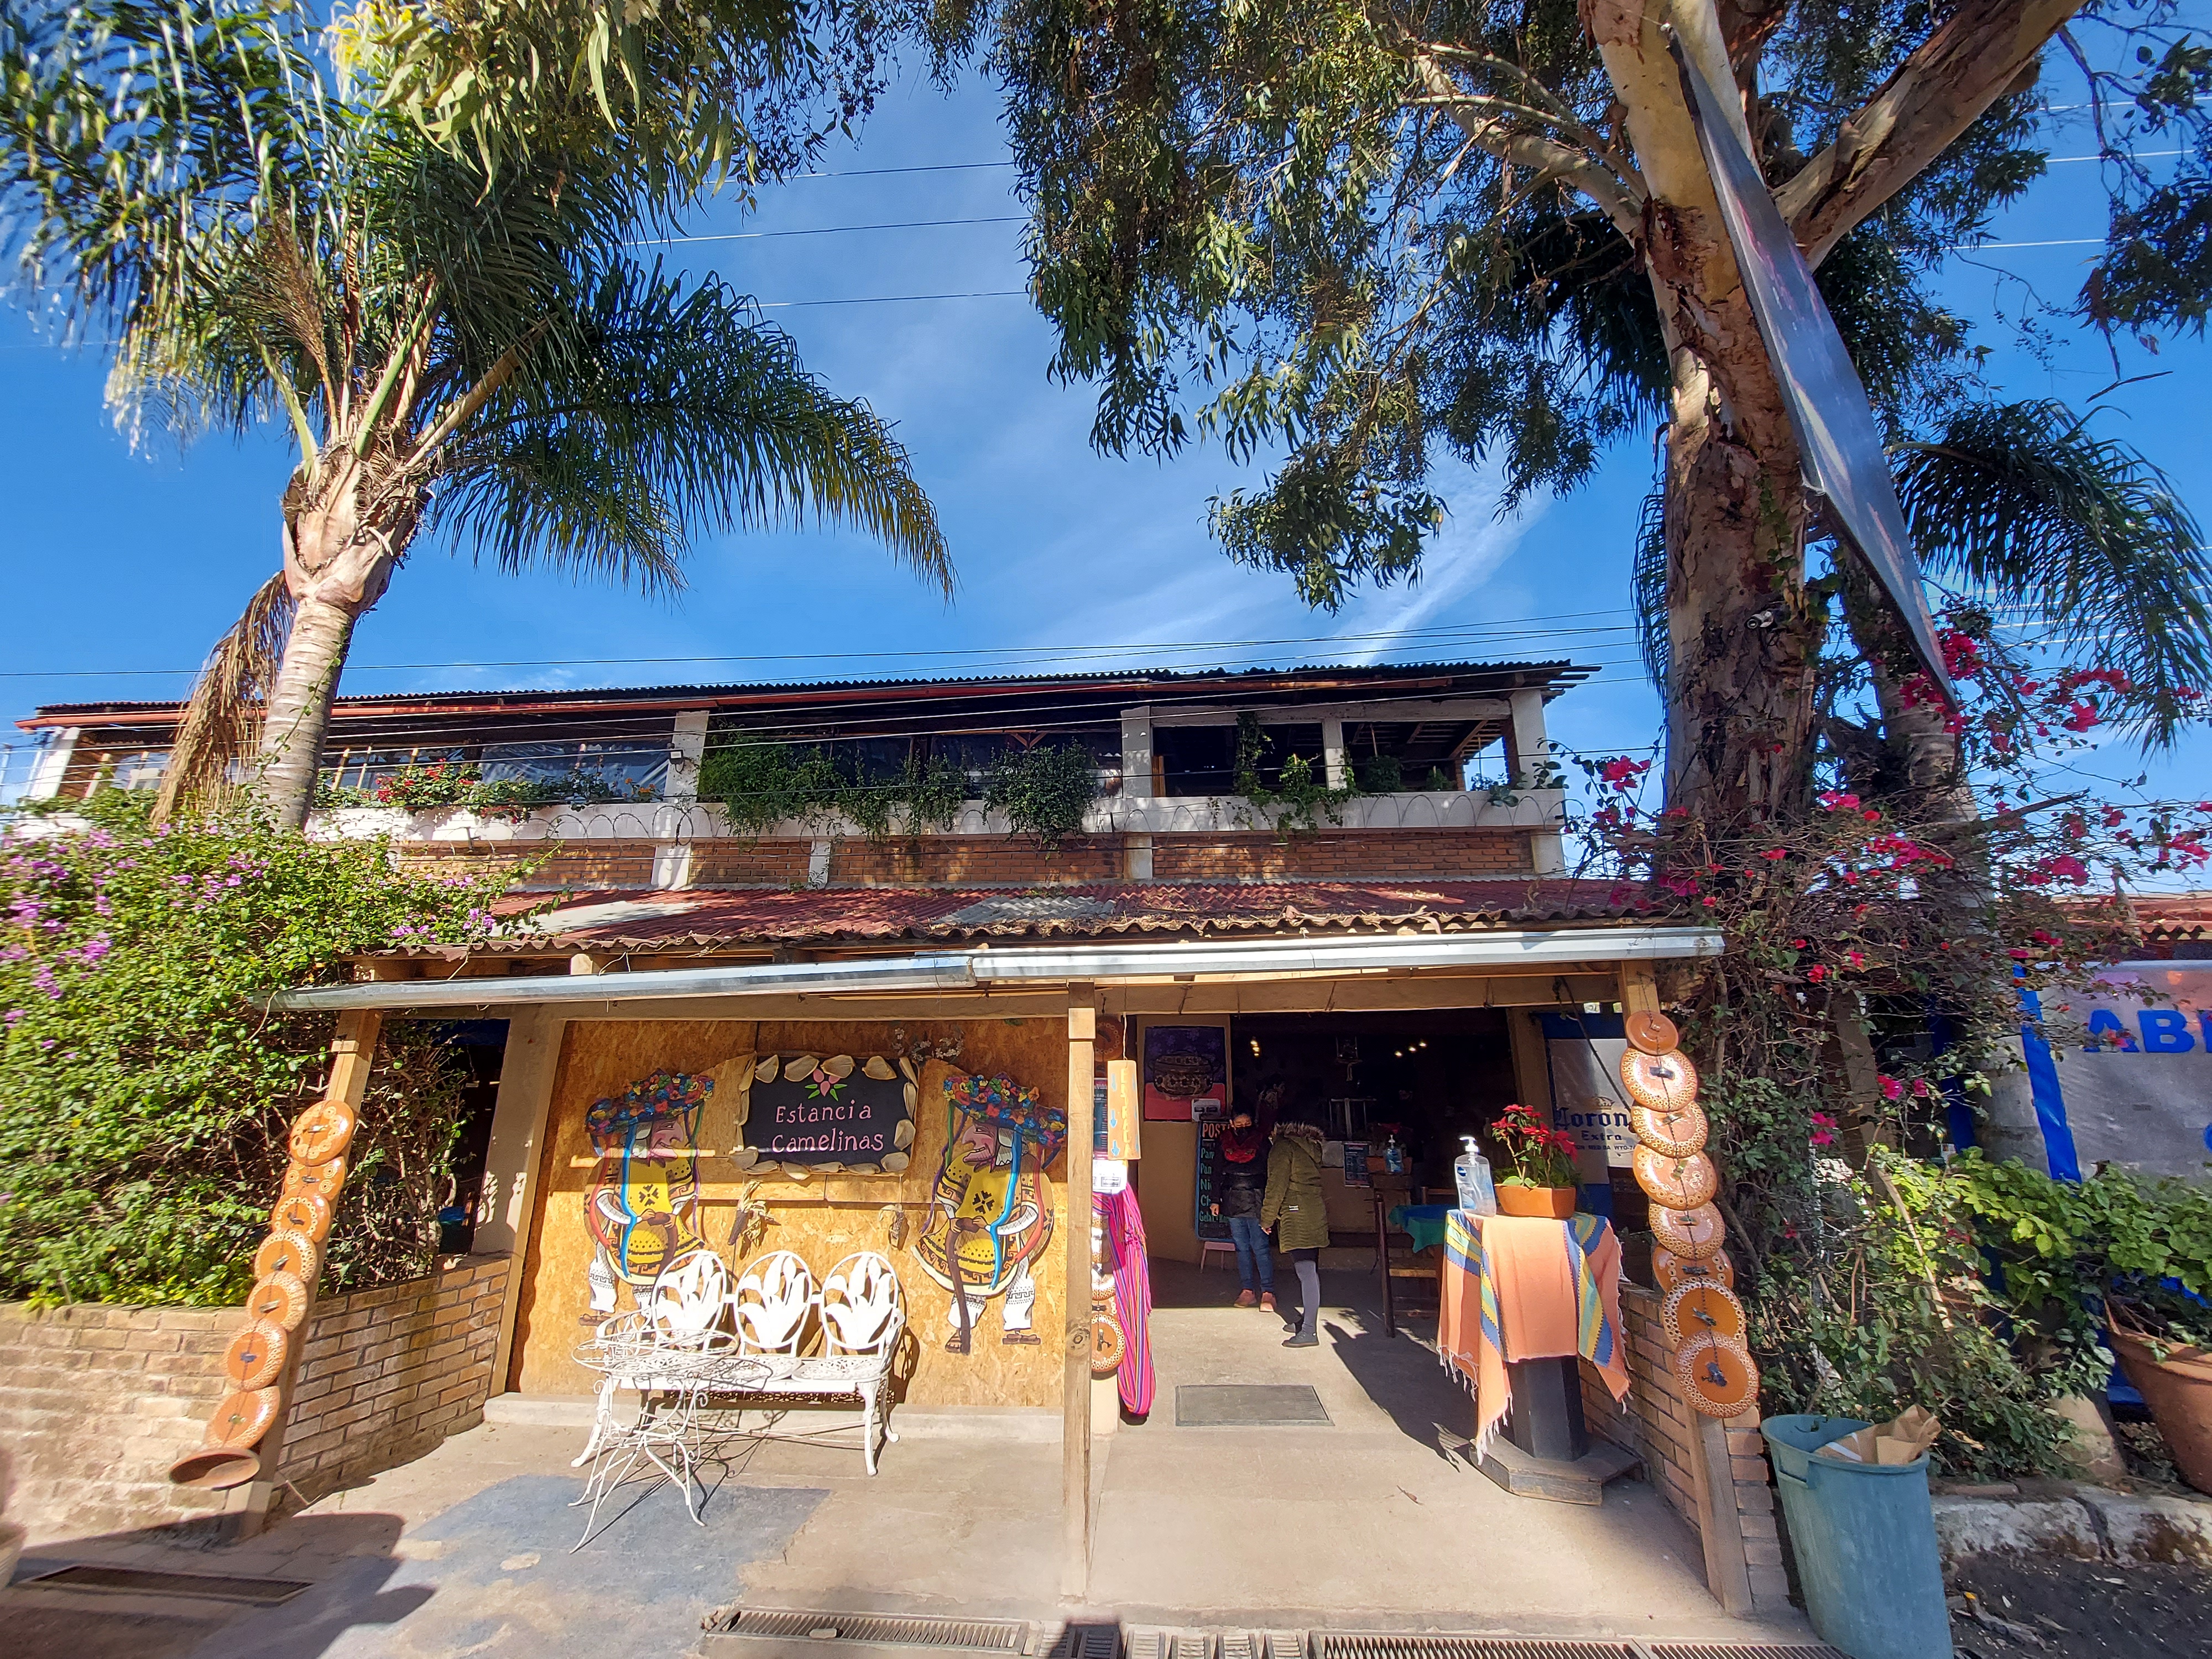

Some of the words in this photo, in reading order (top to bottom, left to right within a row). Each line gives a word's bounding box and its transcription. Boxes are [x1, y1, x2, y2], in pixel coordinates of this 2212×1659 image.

[775, 1099, 872, 1123] Estancia
[1554, 1107, 1630, 1130] Coron
[771, 1128, 884, 1153] Camelinas
[1581, 1130, 1623, 1141] Extra
